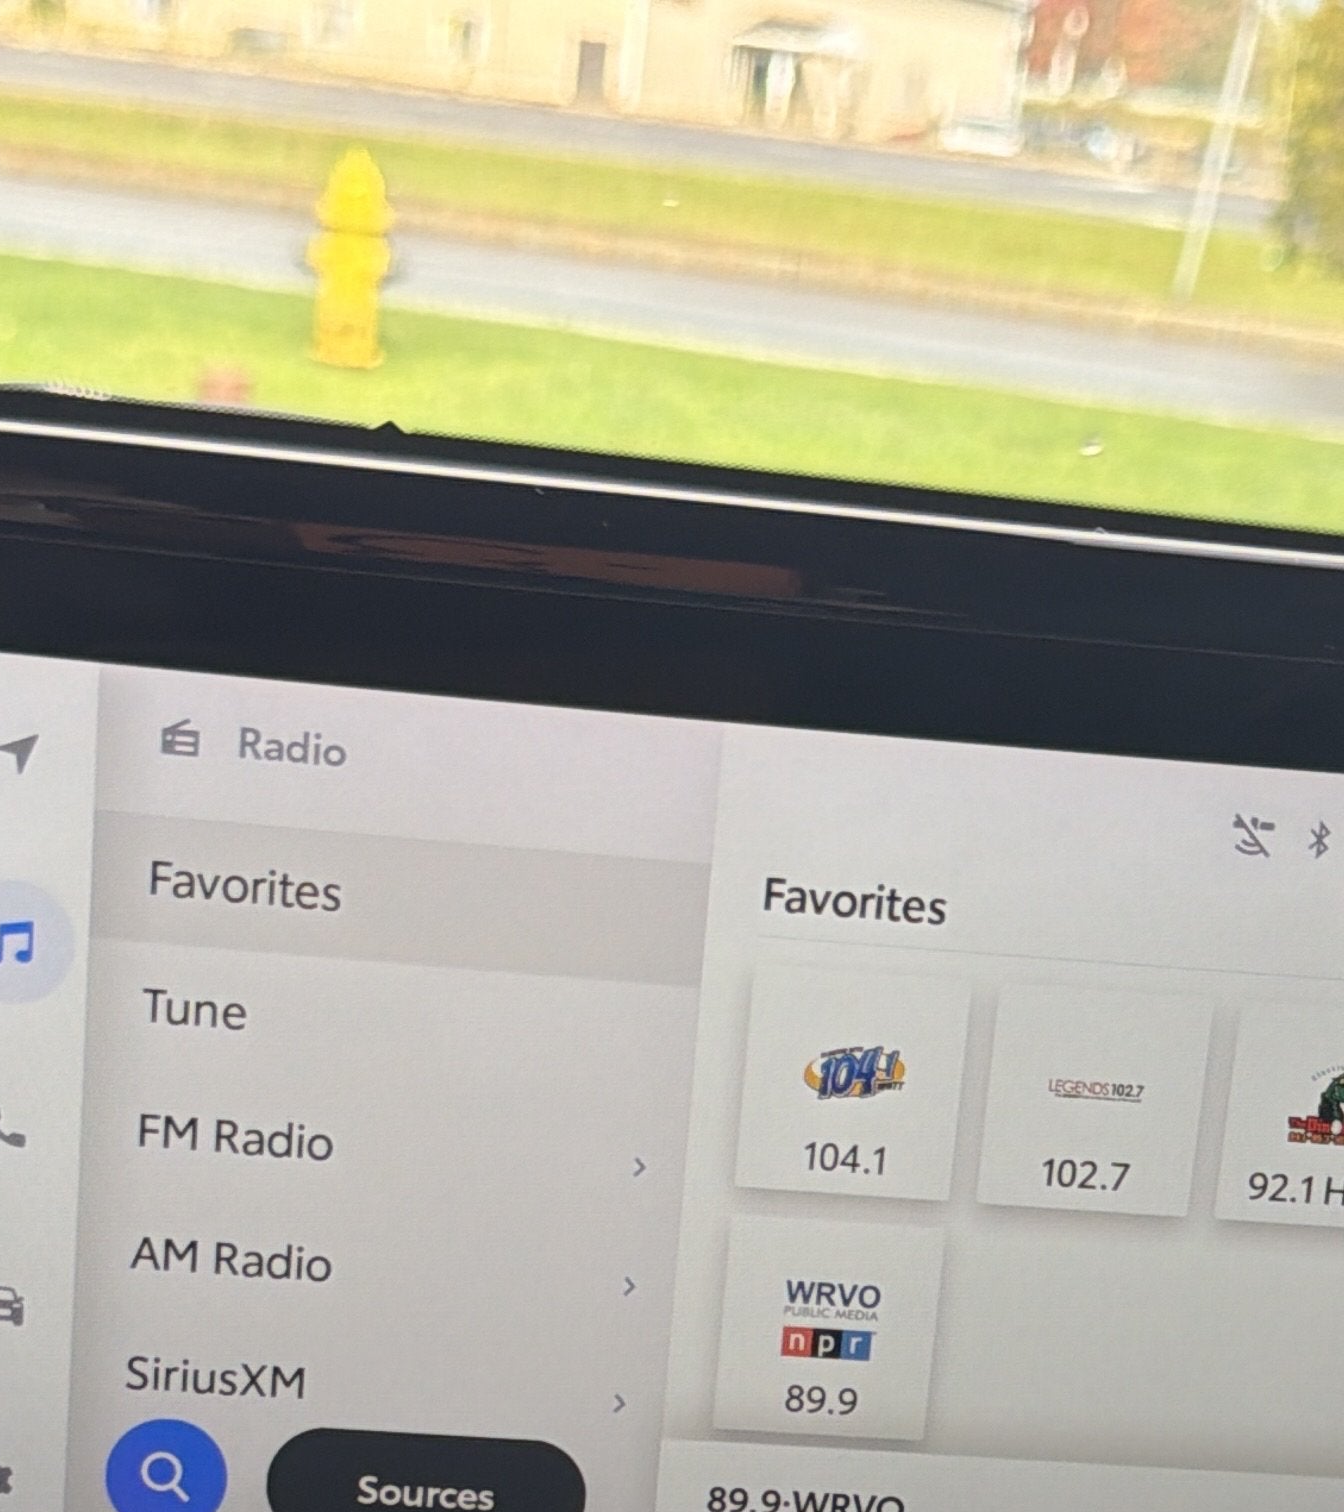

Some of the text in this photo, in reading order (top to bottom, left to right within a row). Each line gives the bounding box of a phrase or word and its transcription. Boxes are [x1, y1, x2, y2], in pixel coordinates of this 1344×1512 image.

[238, 727, 347, 767] Radio
[149, 861, 342, 912] Favorites
[763, 877, 947, 925] Favorites
[143, 989, 247, 1031] Tune
[139, 1114, 334, 1161] FM Radio
[805, 1141, 886, 1175] 104.1
[1043, 1158, 1130, 1191] 102.7
[1249, 1172, 1313, 1204] 92.1
[130, 1237, 332, 1283] AM Radio
[786, 1280, 881, 1309] WRVO
[784, 1306, 878, 1322] PUBLIC MEDIA
[789, 1333, 863, 1358] npr
[126, 1356, 306, 1399] SiriusXM
[785, 1385, 858, 1415] 89.9
[358, 1476, 494, 1512] Sources
